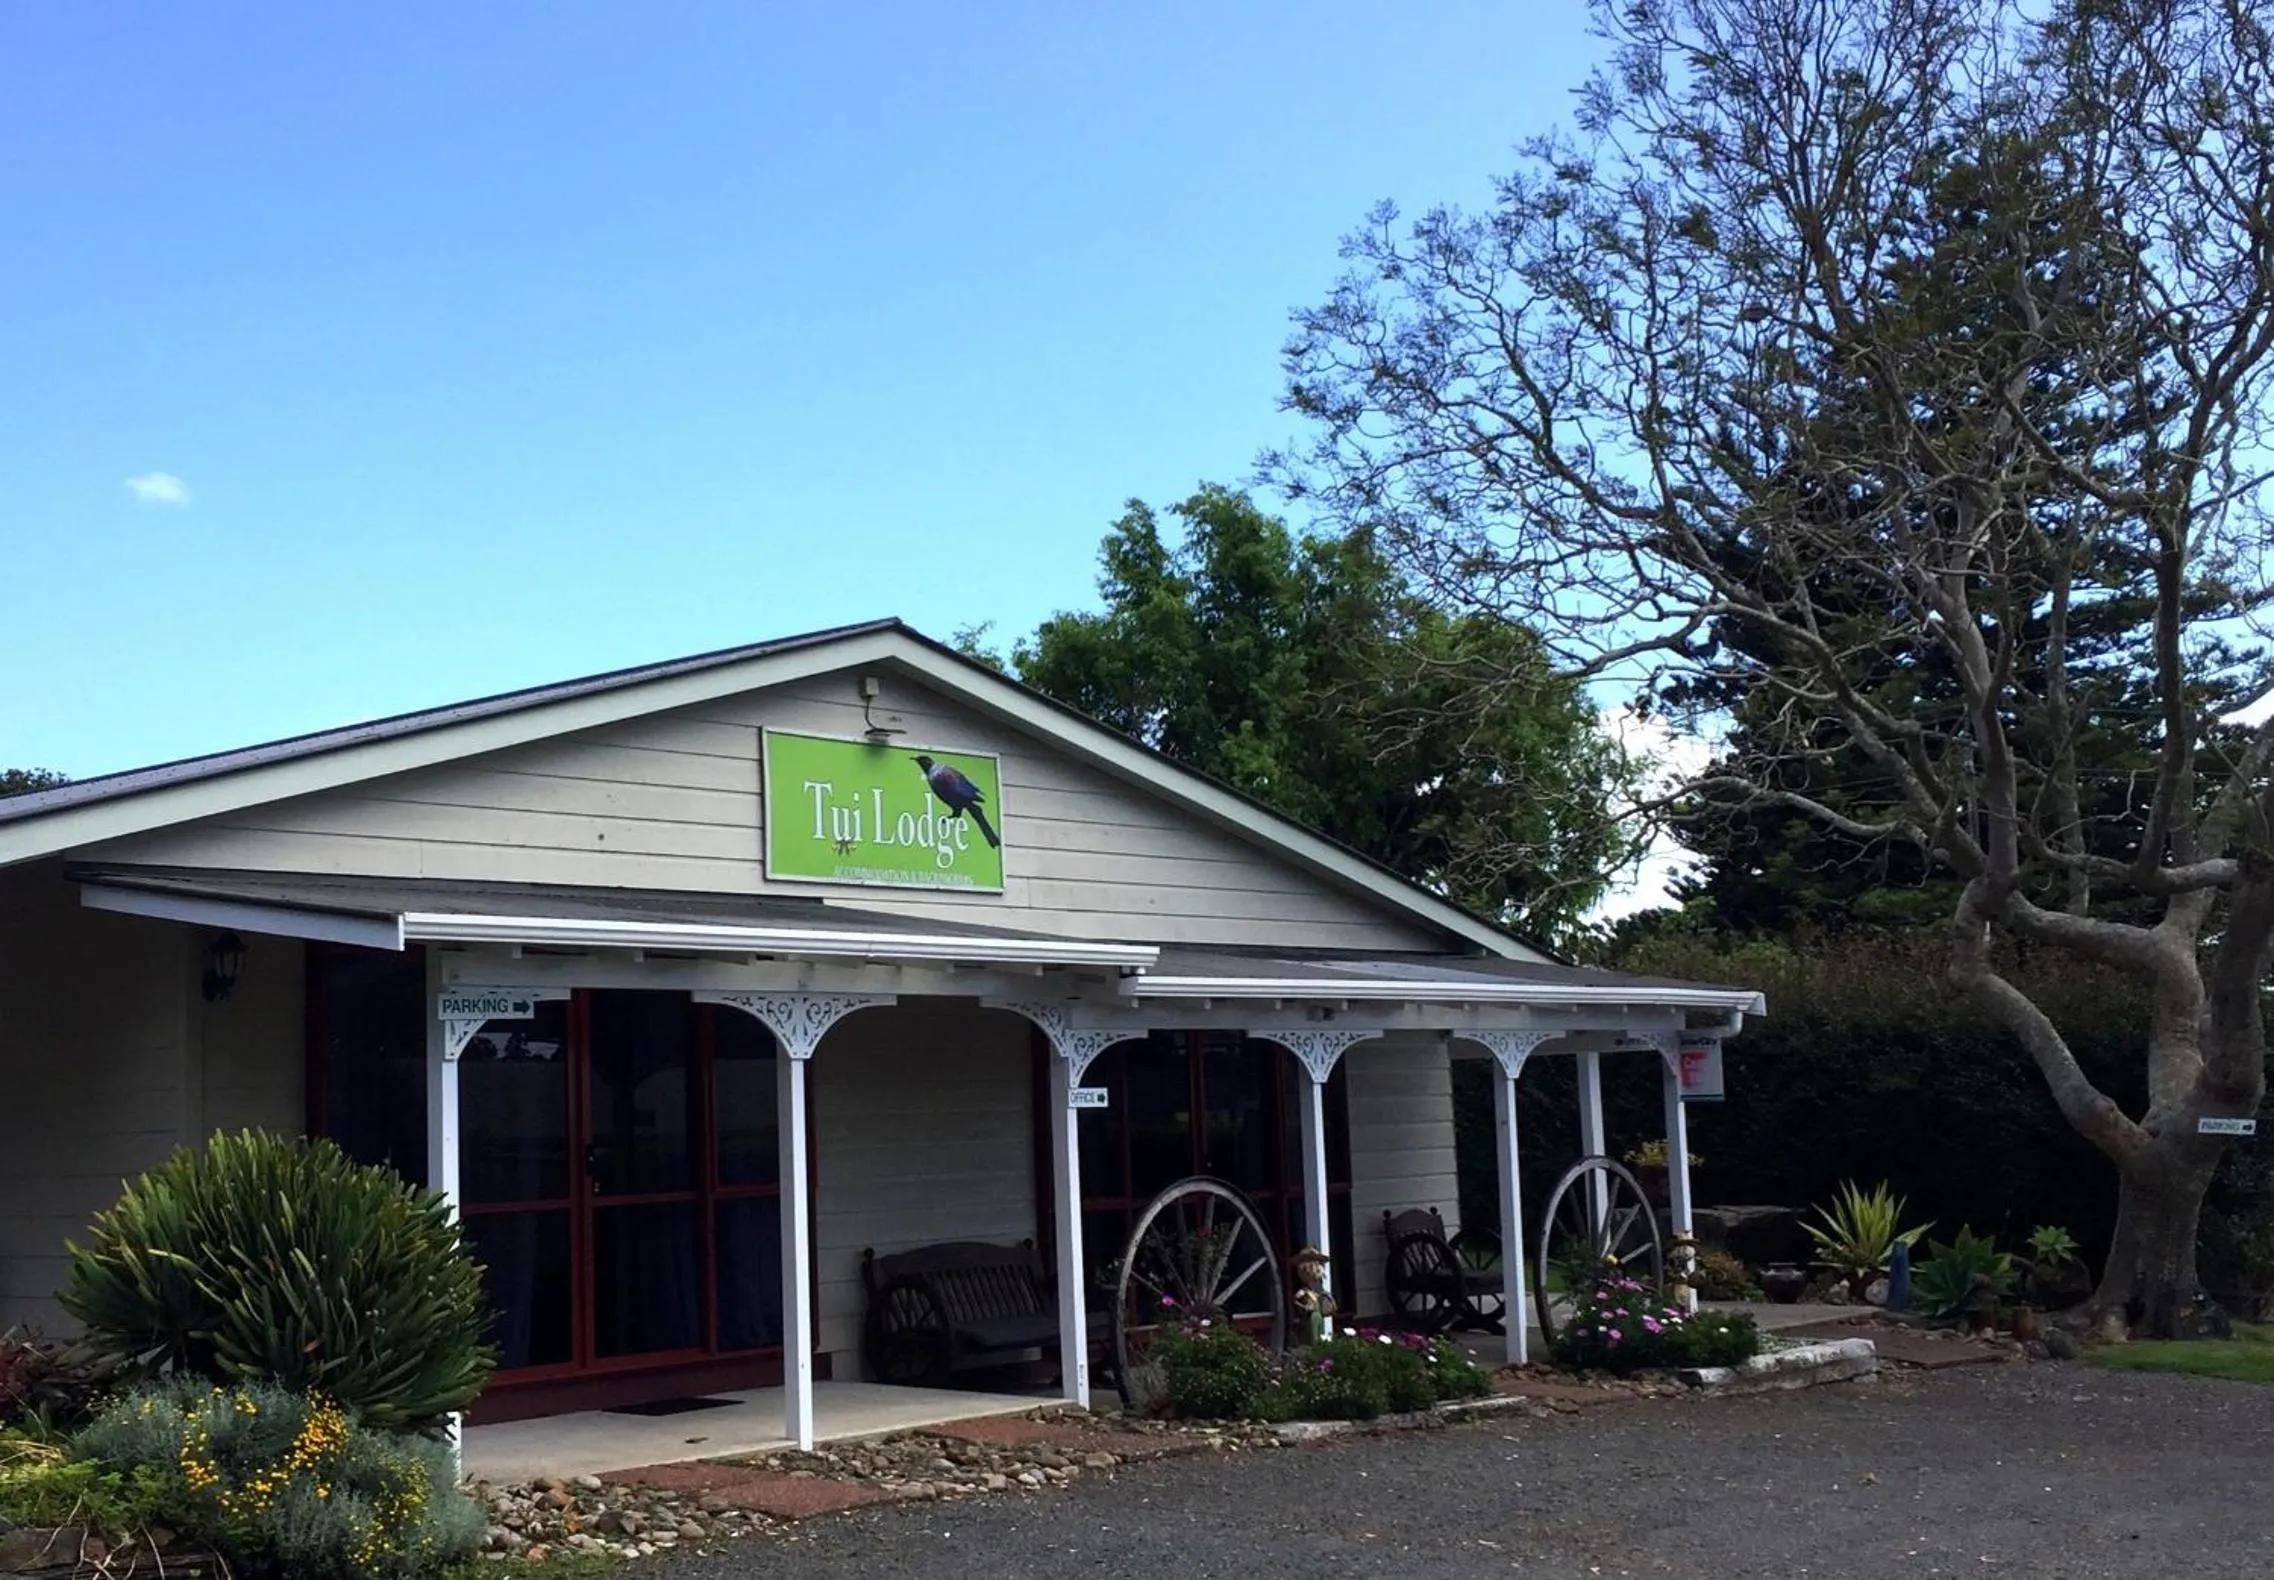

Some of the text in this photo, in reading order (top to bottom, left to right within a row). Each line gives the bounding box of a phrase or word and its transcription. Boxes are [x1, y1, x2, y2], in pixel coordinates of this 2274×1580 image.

[803, 781, 969, 868] Tui Lodge
[443, 998, 509, 1014] PARKING
